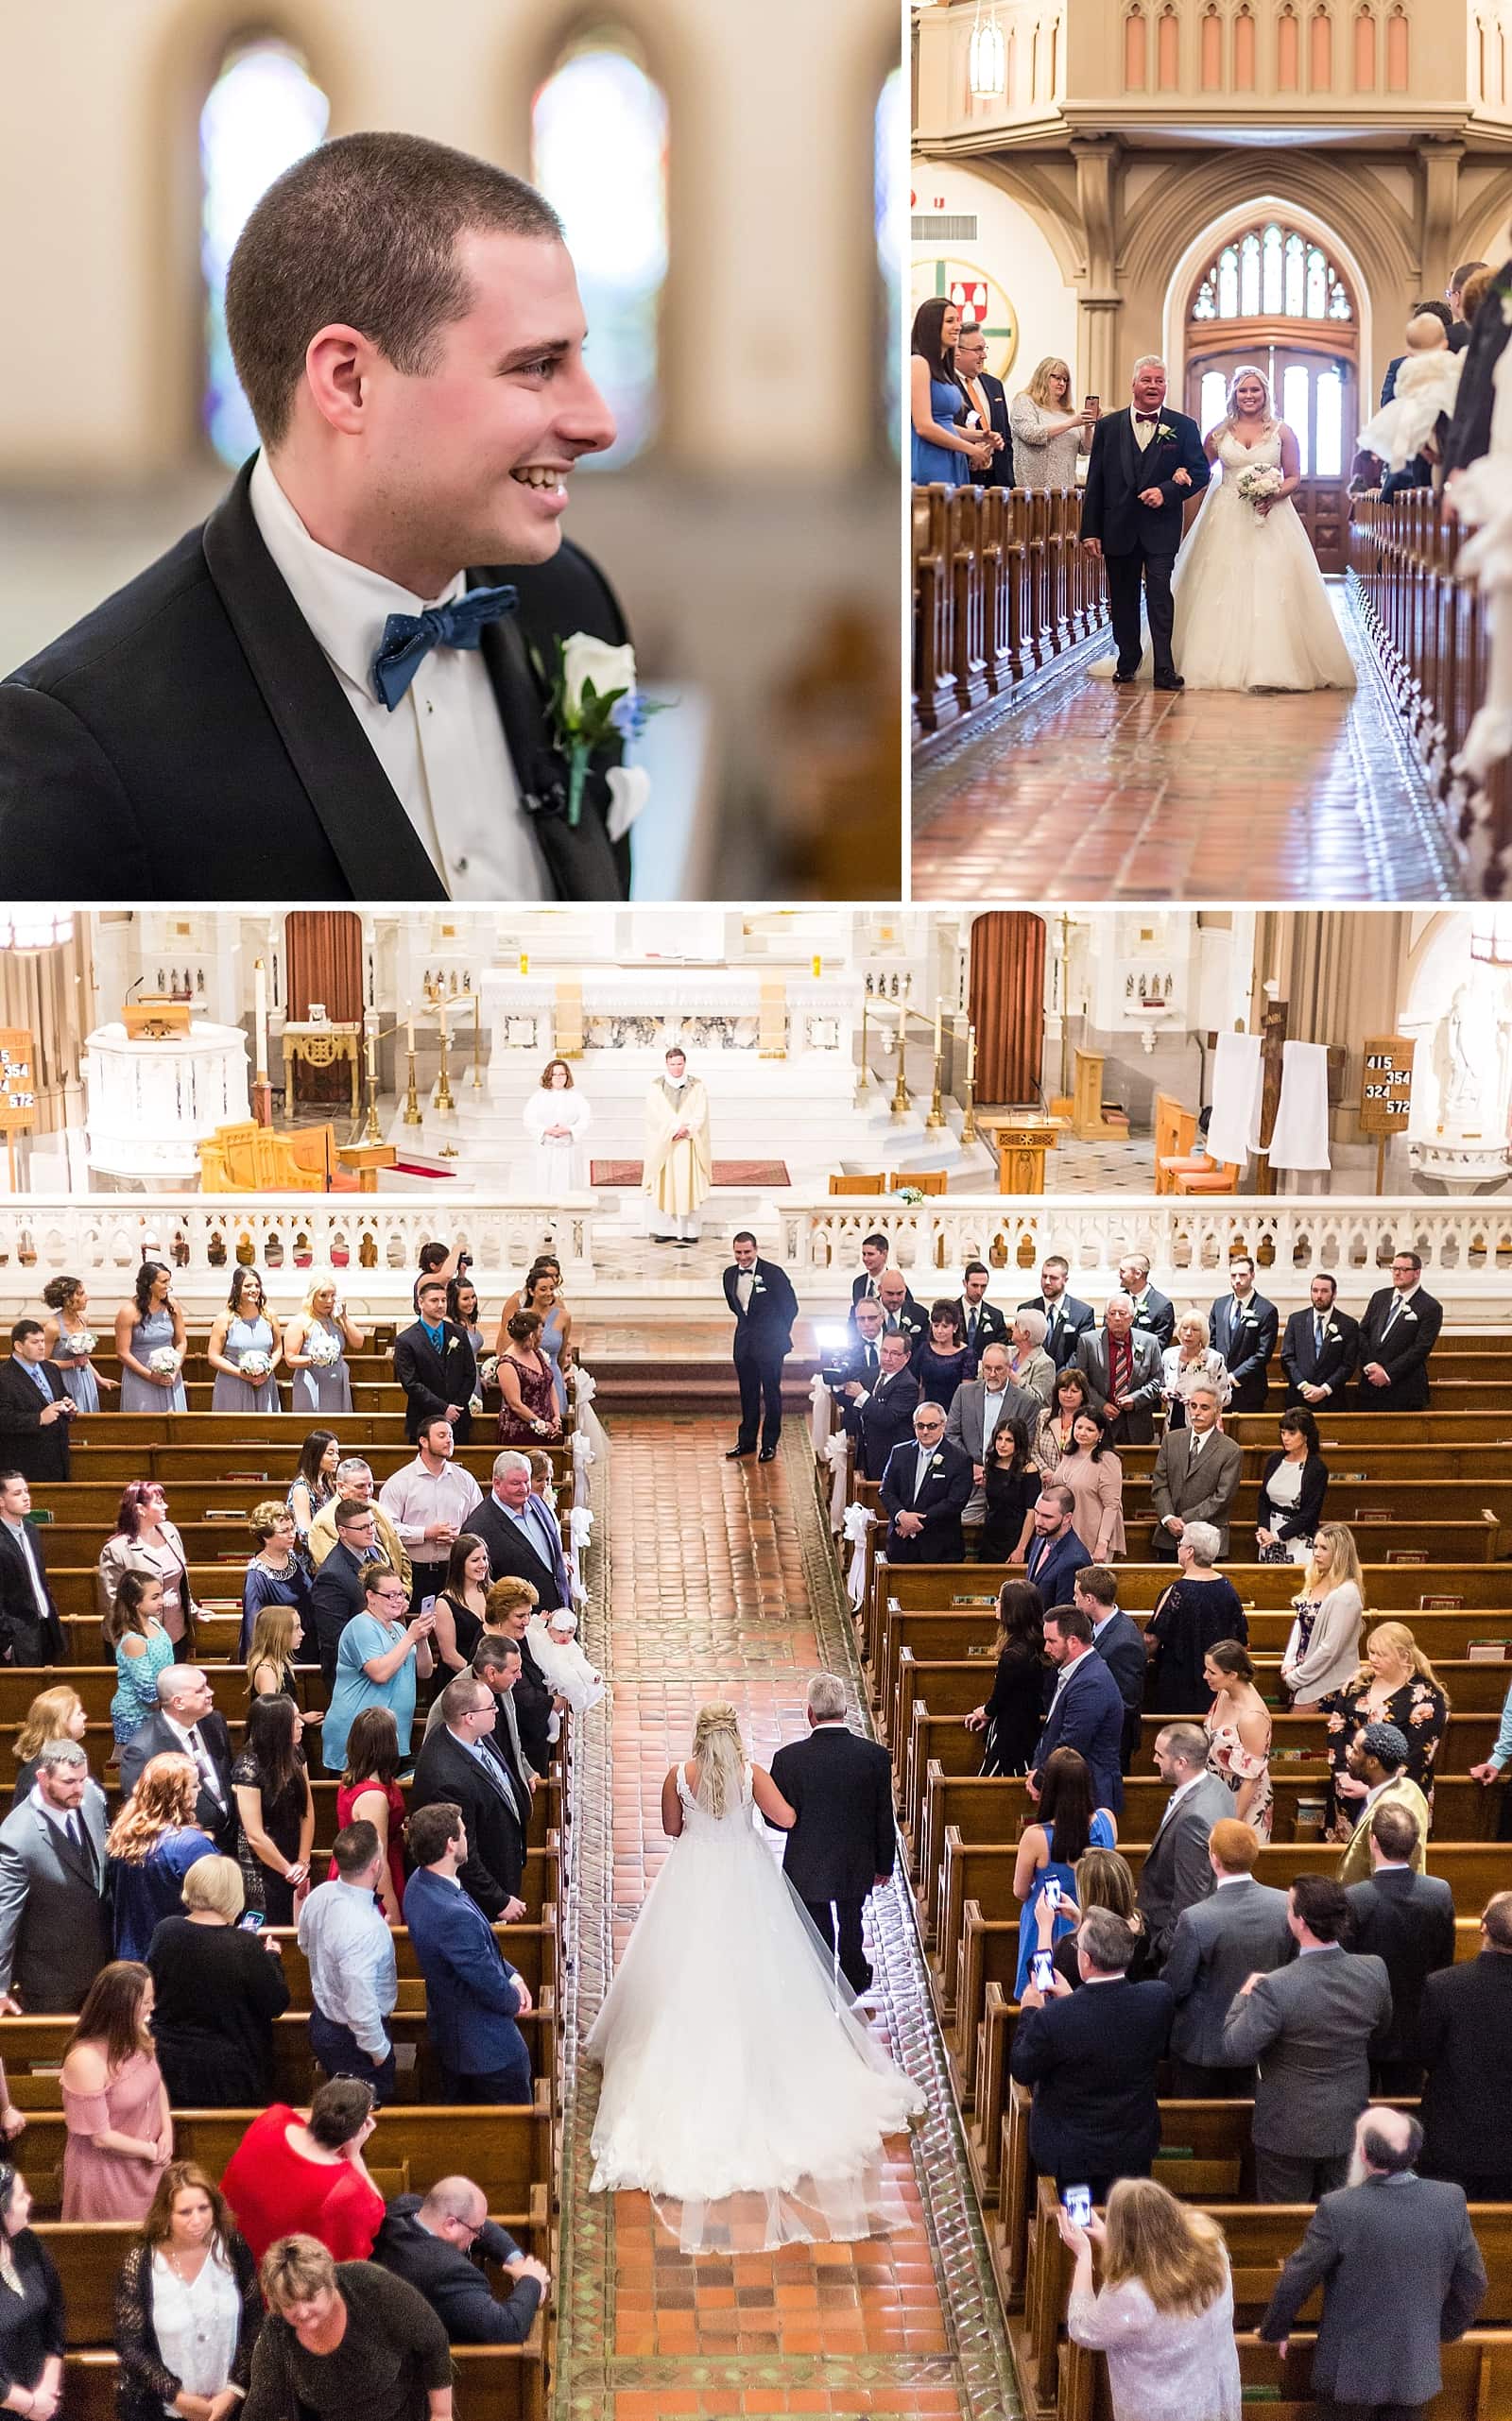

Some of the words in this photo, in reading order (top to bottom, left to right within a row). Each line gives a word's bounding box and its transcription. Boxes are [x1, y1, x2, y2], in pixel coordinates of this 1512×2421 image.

[1366, 1056, 1392, 1069] 415
[4, 1063, 29, 1078] 354
[1385, 1071, 1410, 1084] 354
[1366, 1085, 1391, 1098] 324
[9, 1093, 34, 1108] 572
[1386, 1100, 1410, 1113] 572
